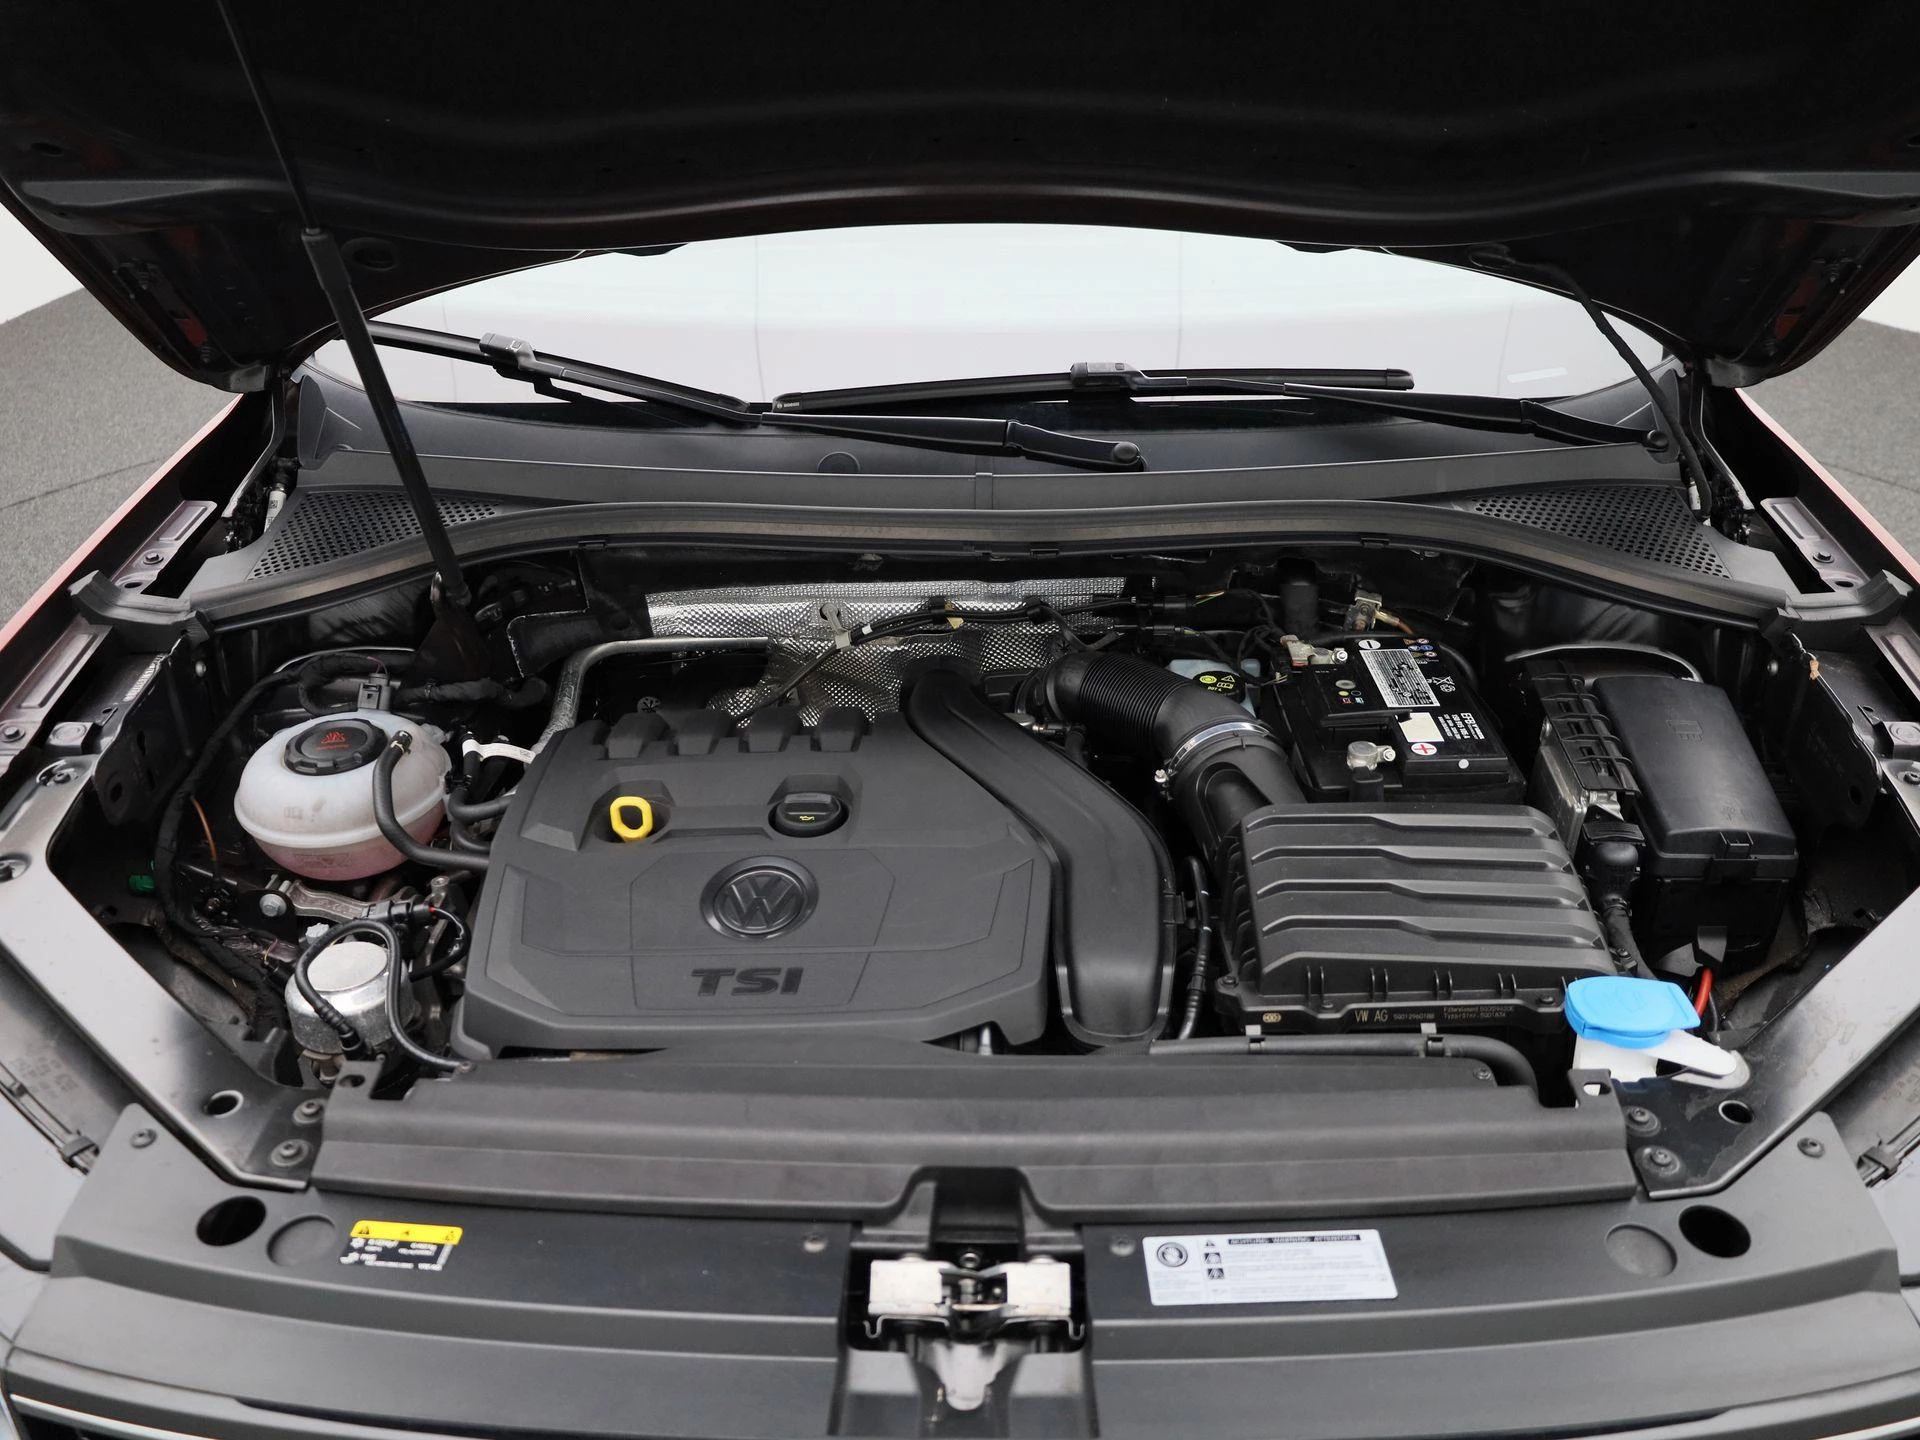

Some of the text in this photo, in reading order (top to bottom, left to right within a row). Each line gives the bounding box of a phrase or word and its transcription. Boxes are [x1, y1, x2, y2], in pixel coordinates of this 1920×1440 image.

[691, 967, 804, 997] TSI
[1354, 1009, 1369, 1022] VW
[1374, 1009, 1389, 1022] AG
